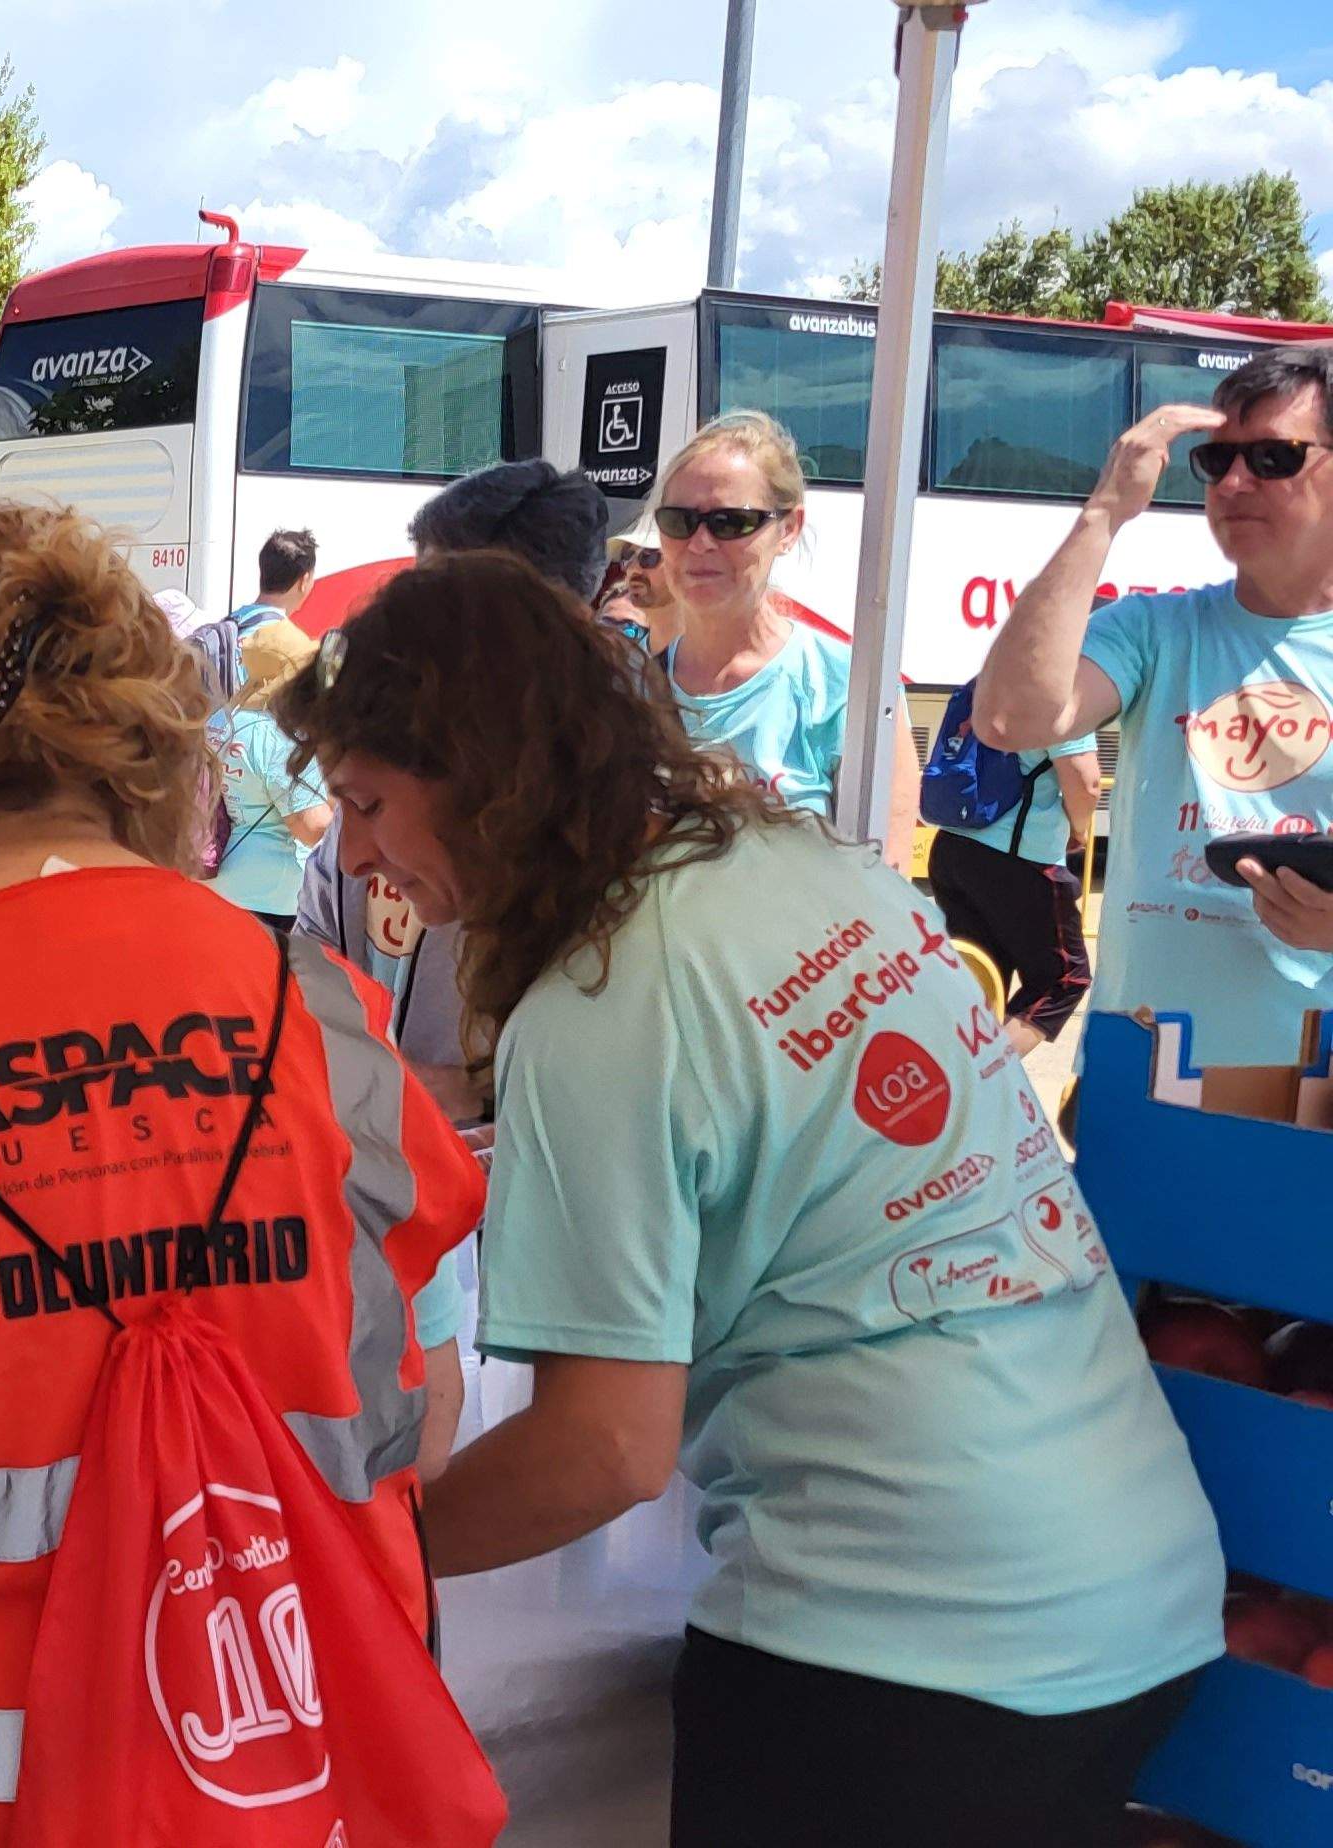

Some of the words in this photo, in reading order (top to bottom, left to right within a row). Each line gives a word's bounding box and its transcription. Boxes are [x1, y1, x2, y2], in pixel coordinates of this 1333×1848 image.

[789, 313, 876, 338] avanzabus
[32, 346, 128, 382] avanza
[605, 382, 640, 395] ACCESO
[152, 548, 185, 567] 8410
[747, 918, 874, 1028] Fundación
[59, 1161, 128, 1185] Personas
[884, 1157, 981, 1222] avanza
